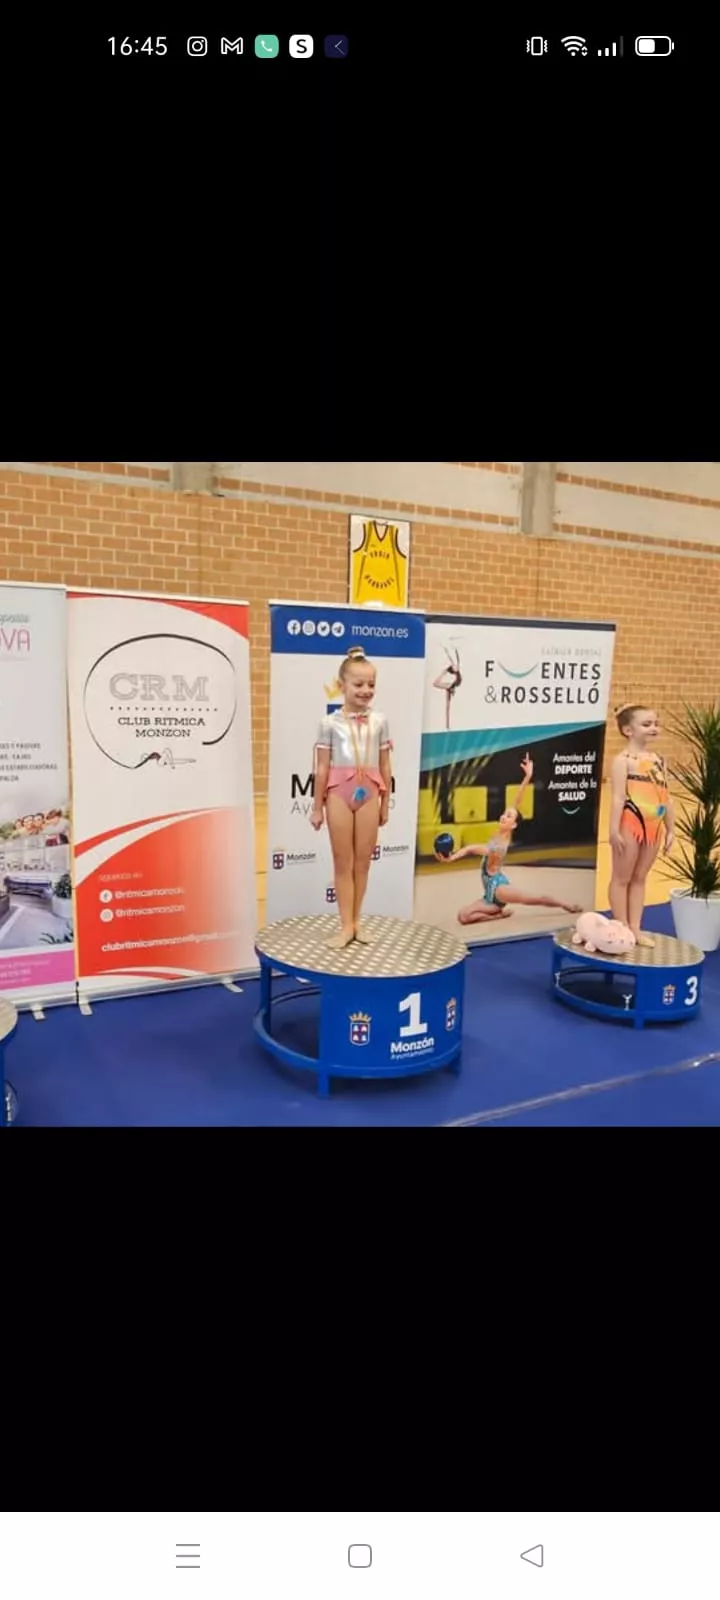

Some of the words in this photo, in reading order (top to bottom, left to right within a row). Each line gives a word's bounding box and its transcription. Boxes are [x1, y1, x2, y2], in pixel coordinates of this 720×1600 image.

[351, 624, 409, 638] monzon.es
[0, 628, 31, 651] VA
[108, 672, 210, 701] CRM
[117, 716, 151, 727] CLUB
[154, 717, 206, 727] RITMICA
[135, 728, 191, 738] MONZON
[553, 753, 583, 762] Amantes
[585, 751, 596, 762] del
[555, 764, 592, 775] DEPORTE
[548, 780, 578, 790] Amantes
[580, 777, 589, 789] de
[558, 791, 586, 802] SALUD
[684, 976, 698, 1005] 3
[398, 992, 428, 1037] 1
[390, 1037, 434, 1053] Monzón
